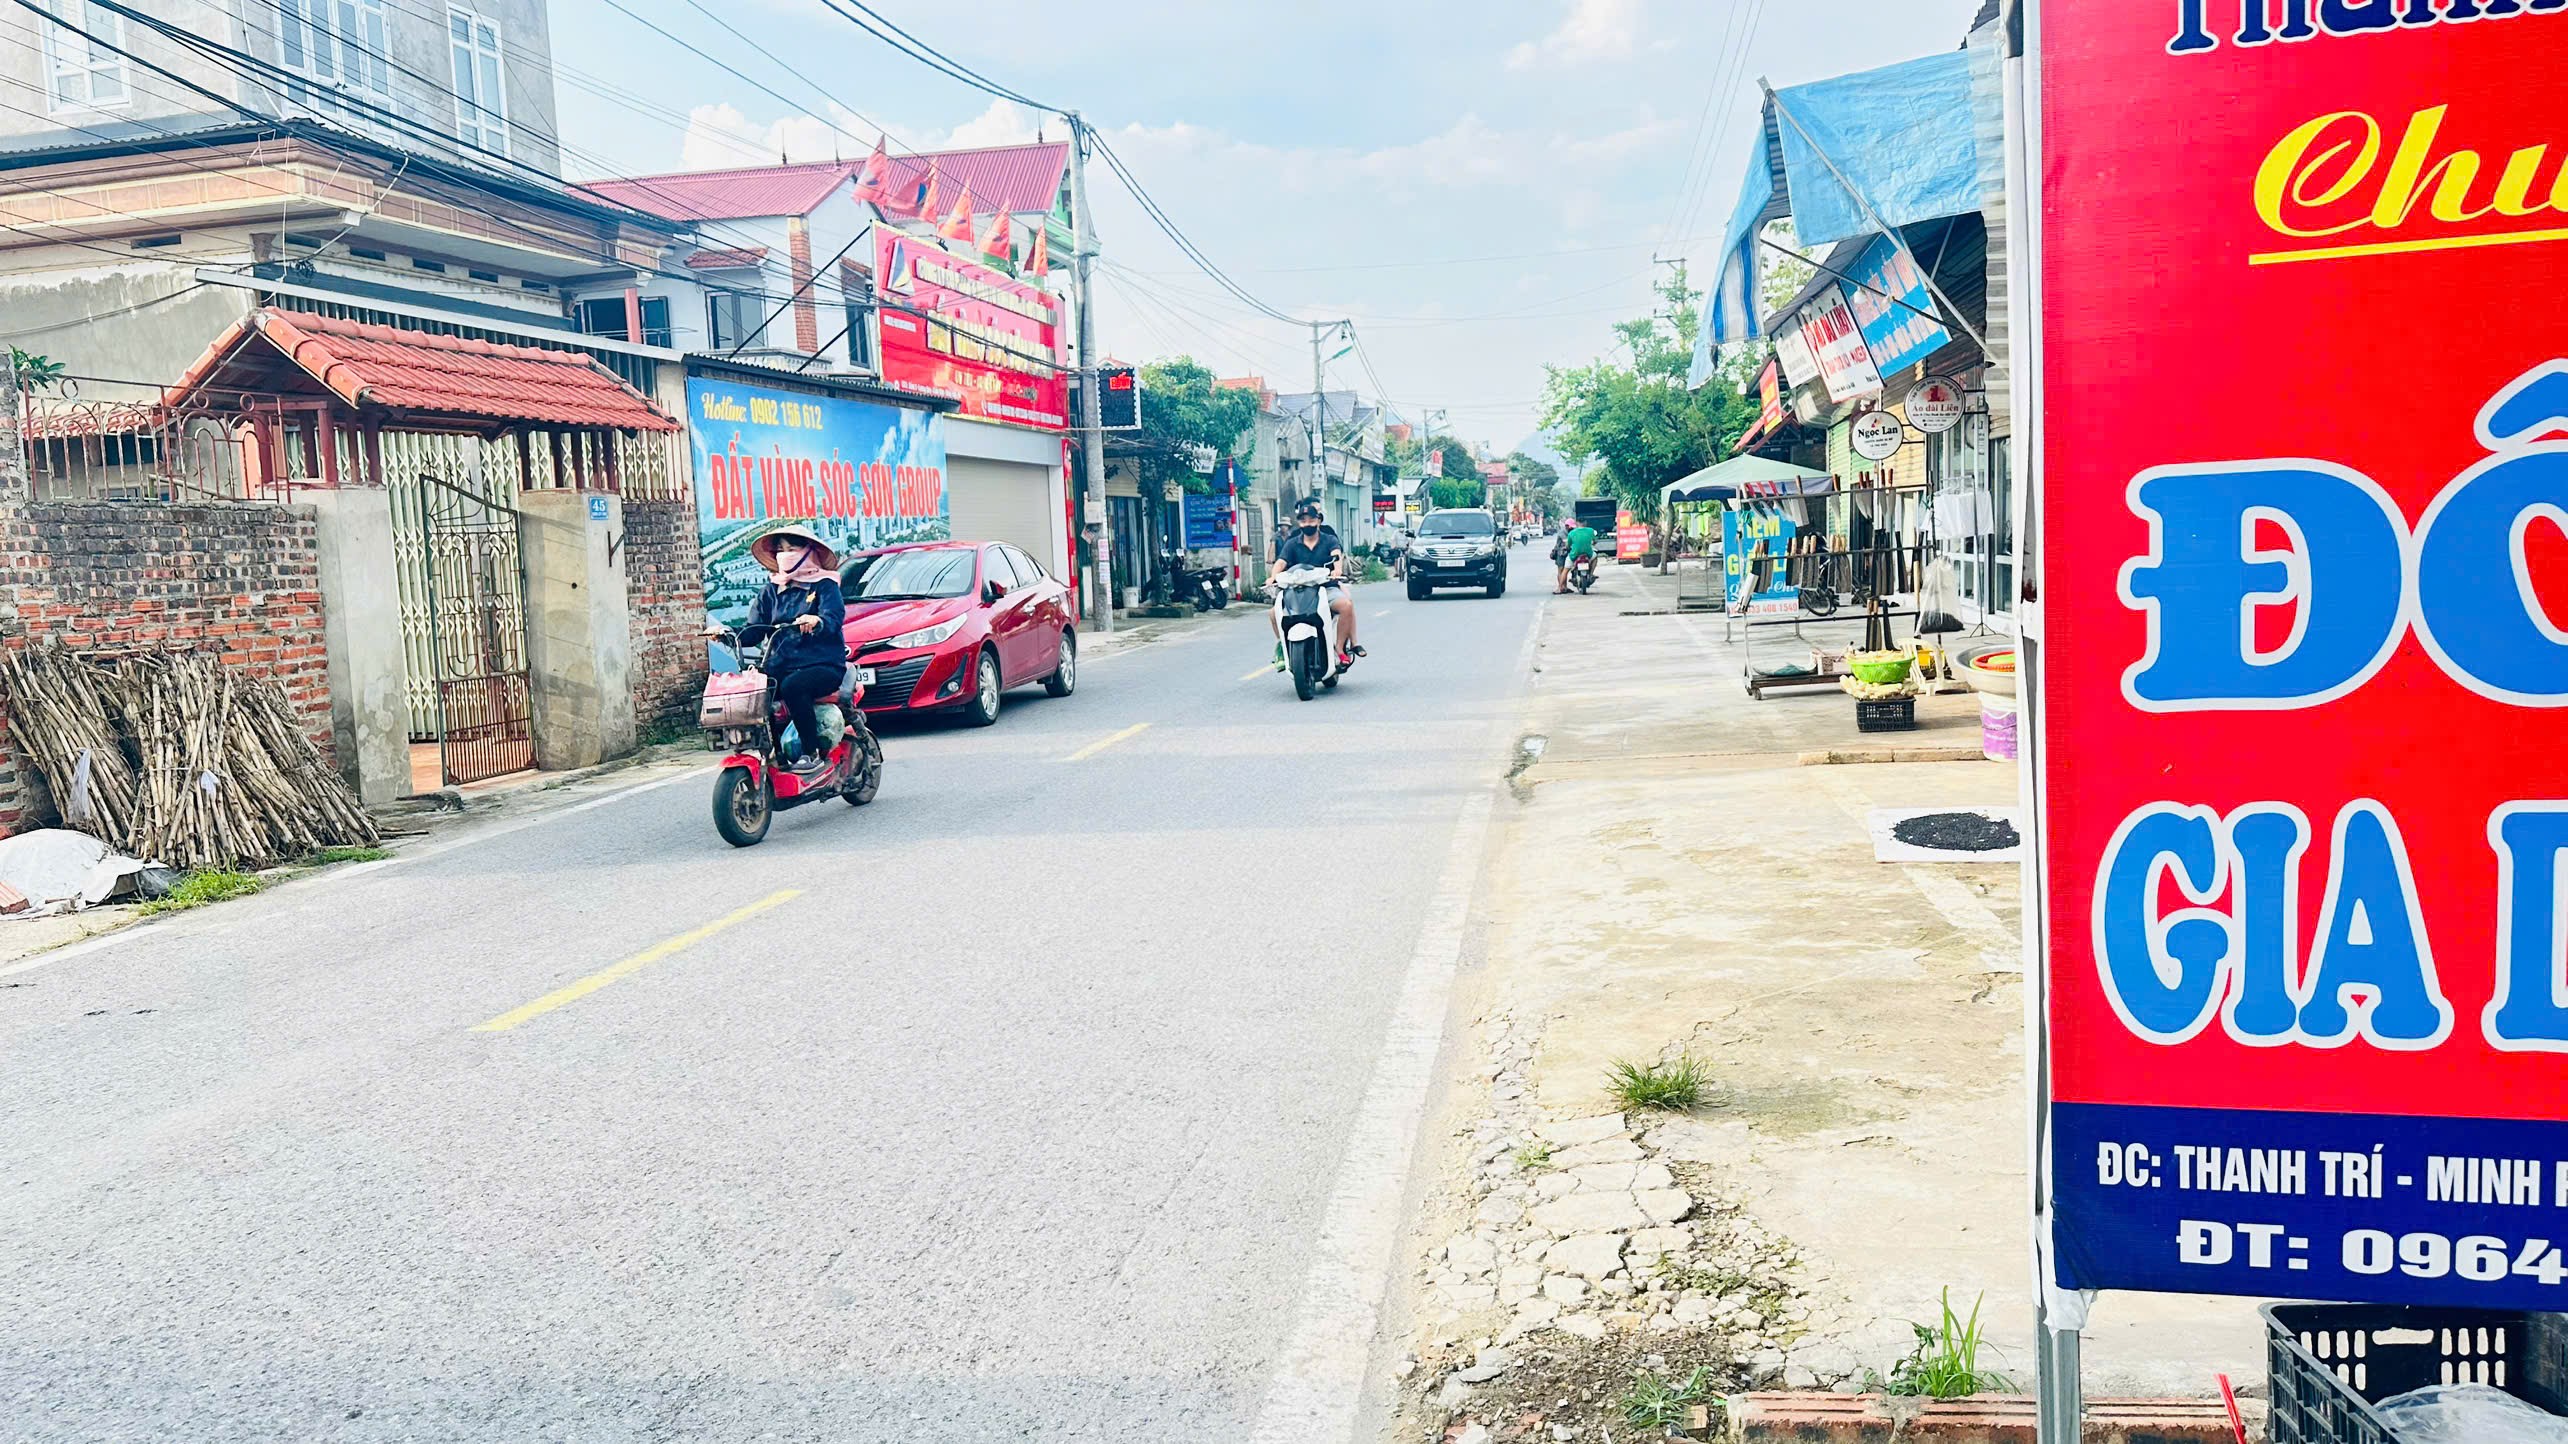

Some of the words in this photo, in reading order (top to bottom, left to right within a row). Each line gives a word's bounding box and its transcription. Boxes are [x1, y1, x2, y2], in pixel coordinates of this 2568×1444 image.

[750, 397, 779, 425] 0902
[1858, 428, 1879, 439] Ngọc
[1881, 425, 1898, 435] Lan
[711, 431, 754, 519] ĐẤT
[759, 444, 816, 518] VÀNG
[820, 448, 857, 518] SÓC
[860, 459, 895, 518] SƠN
[896, 465, 941, 517] GROUP
[592, 499, 606, 512] 45
[2091, 797, 2455, 1051] GIA
[2097, 1141, 2161, 1188] ĐC:
[2174, 1145, 2306, 1195] THANH
[2319, 1143, 2383, 1198] TRÍ
[2427, 1156, 2540, 1206] MINH
[2176, 1219, 2308, 1270] ĐT:
